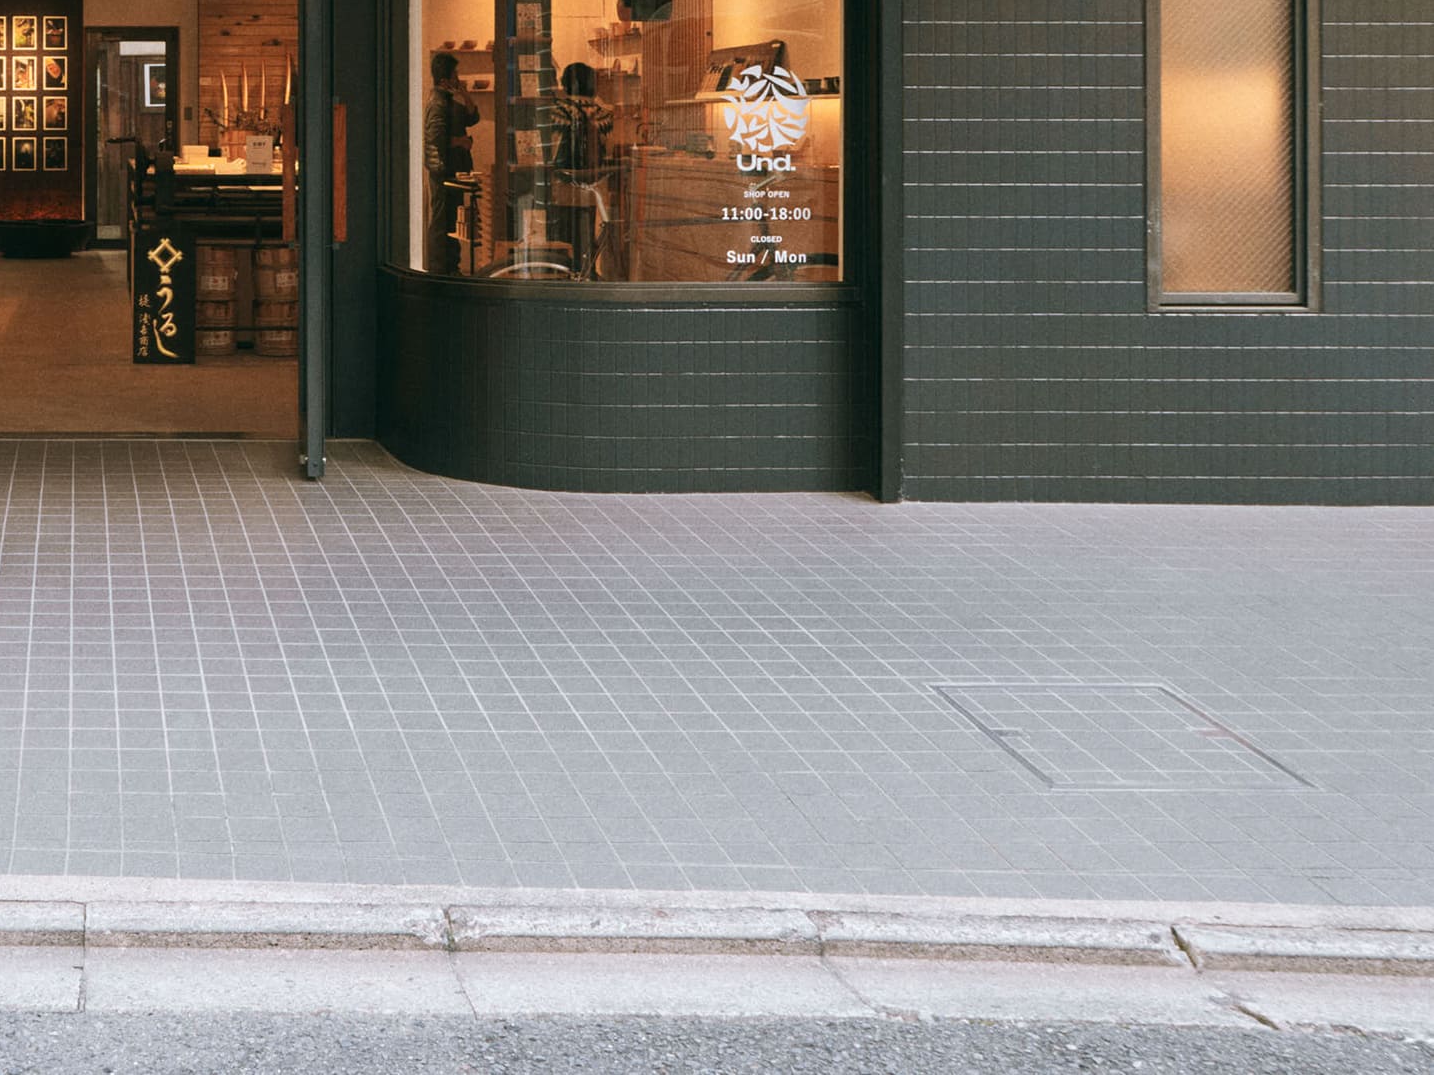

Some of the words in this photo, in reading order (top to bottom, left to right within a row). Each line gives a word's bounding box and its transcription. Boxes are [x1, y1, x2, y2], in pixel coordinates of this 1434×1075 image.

[736, 154, 796, 172] Und.
[743, 190, 766, 198] SHOP
[767, 190, 790, 198] OPEN
[721, 207, 811, 221] 11:00-18:00
[750, 235, 783, 244] CLOSED
[726, 250, 756, 264] Sun
[774, 250, 807, 264] Mon
